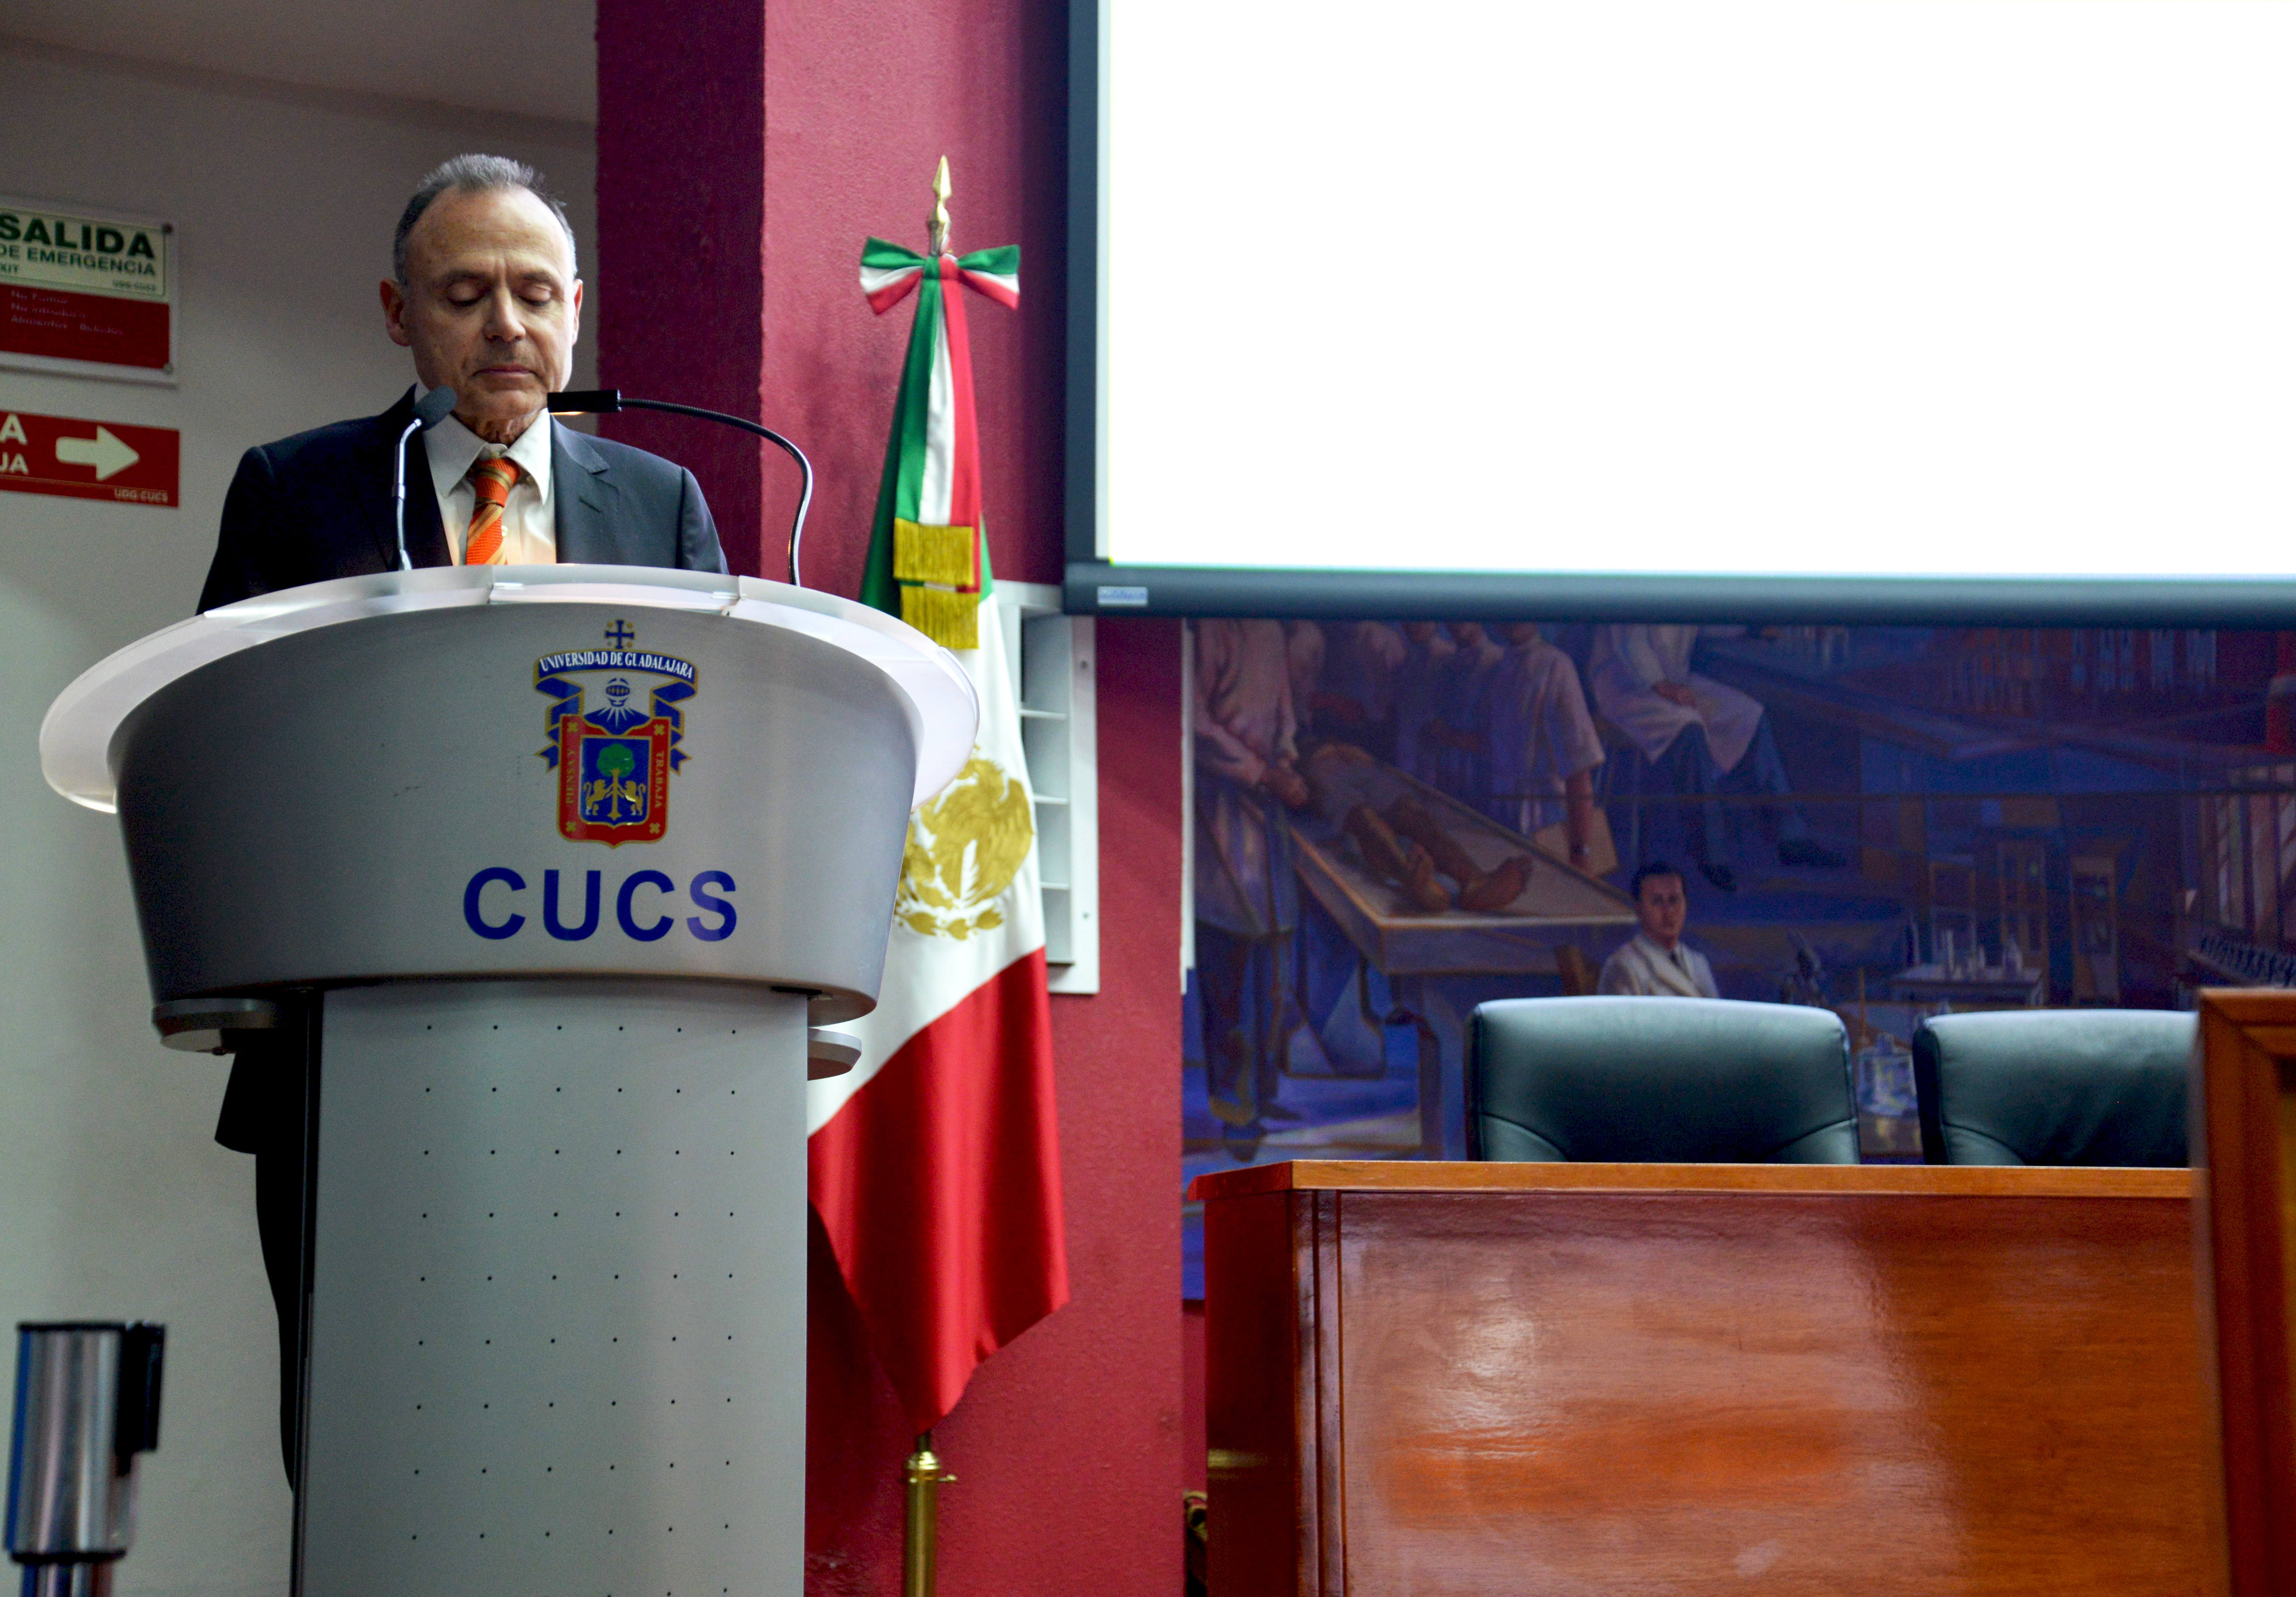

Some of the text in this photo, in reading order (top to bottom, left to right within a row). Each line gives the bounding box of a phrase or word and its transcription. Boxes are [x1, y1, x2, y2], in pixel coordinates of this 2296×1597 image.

[0, 214, 154, 258] SALIDA
[27, 247, 156, 277] EMERGENCIA
[539, 651, 608, 672] UNIVERSIDAD
[610, 652, 623, 665] DE
[654, 750, 665, 809] TRABAJA
[463, 867, 737, 942] CUCS
